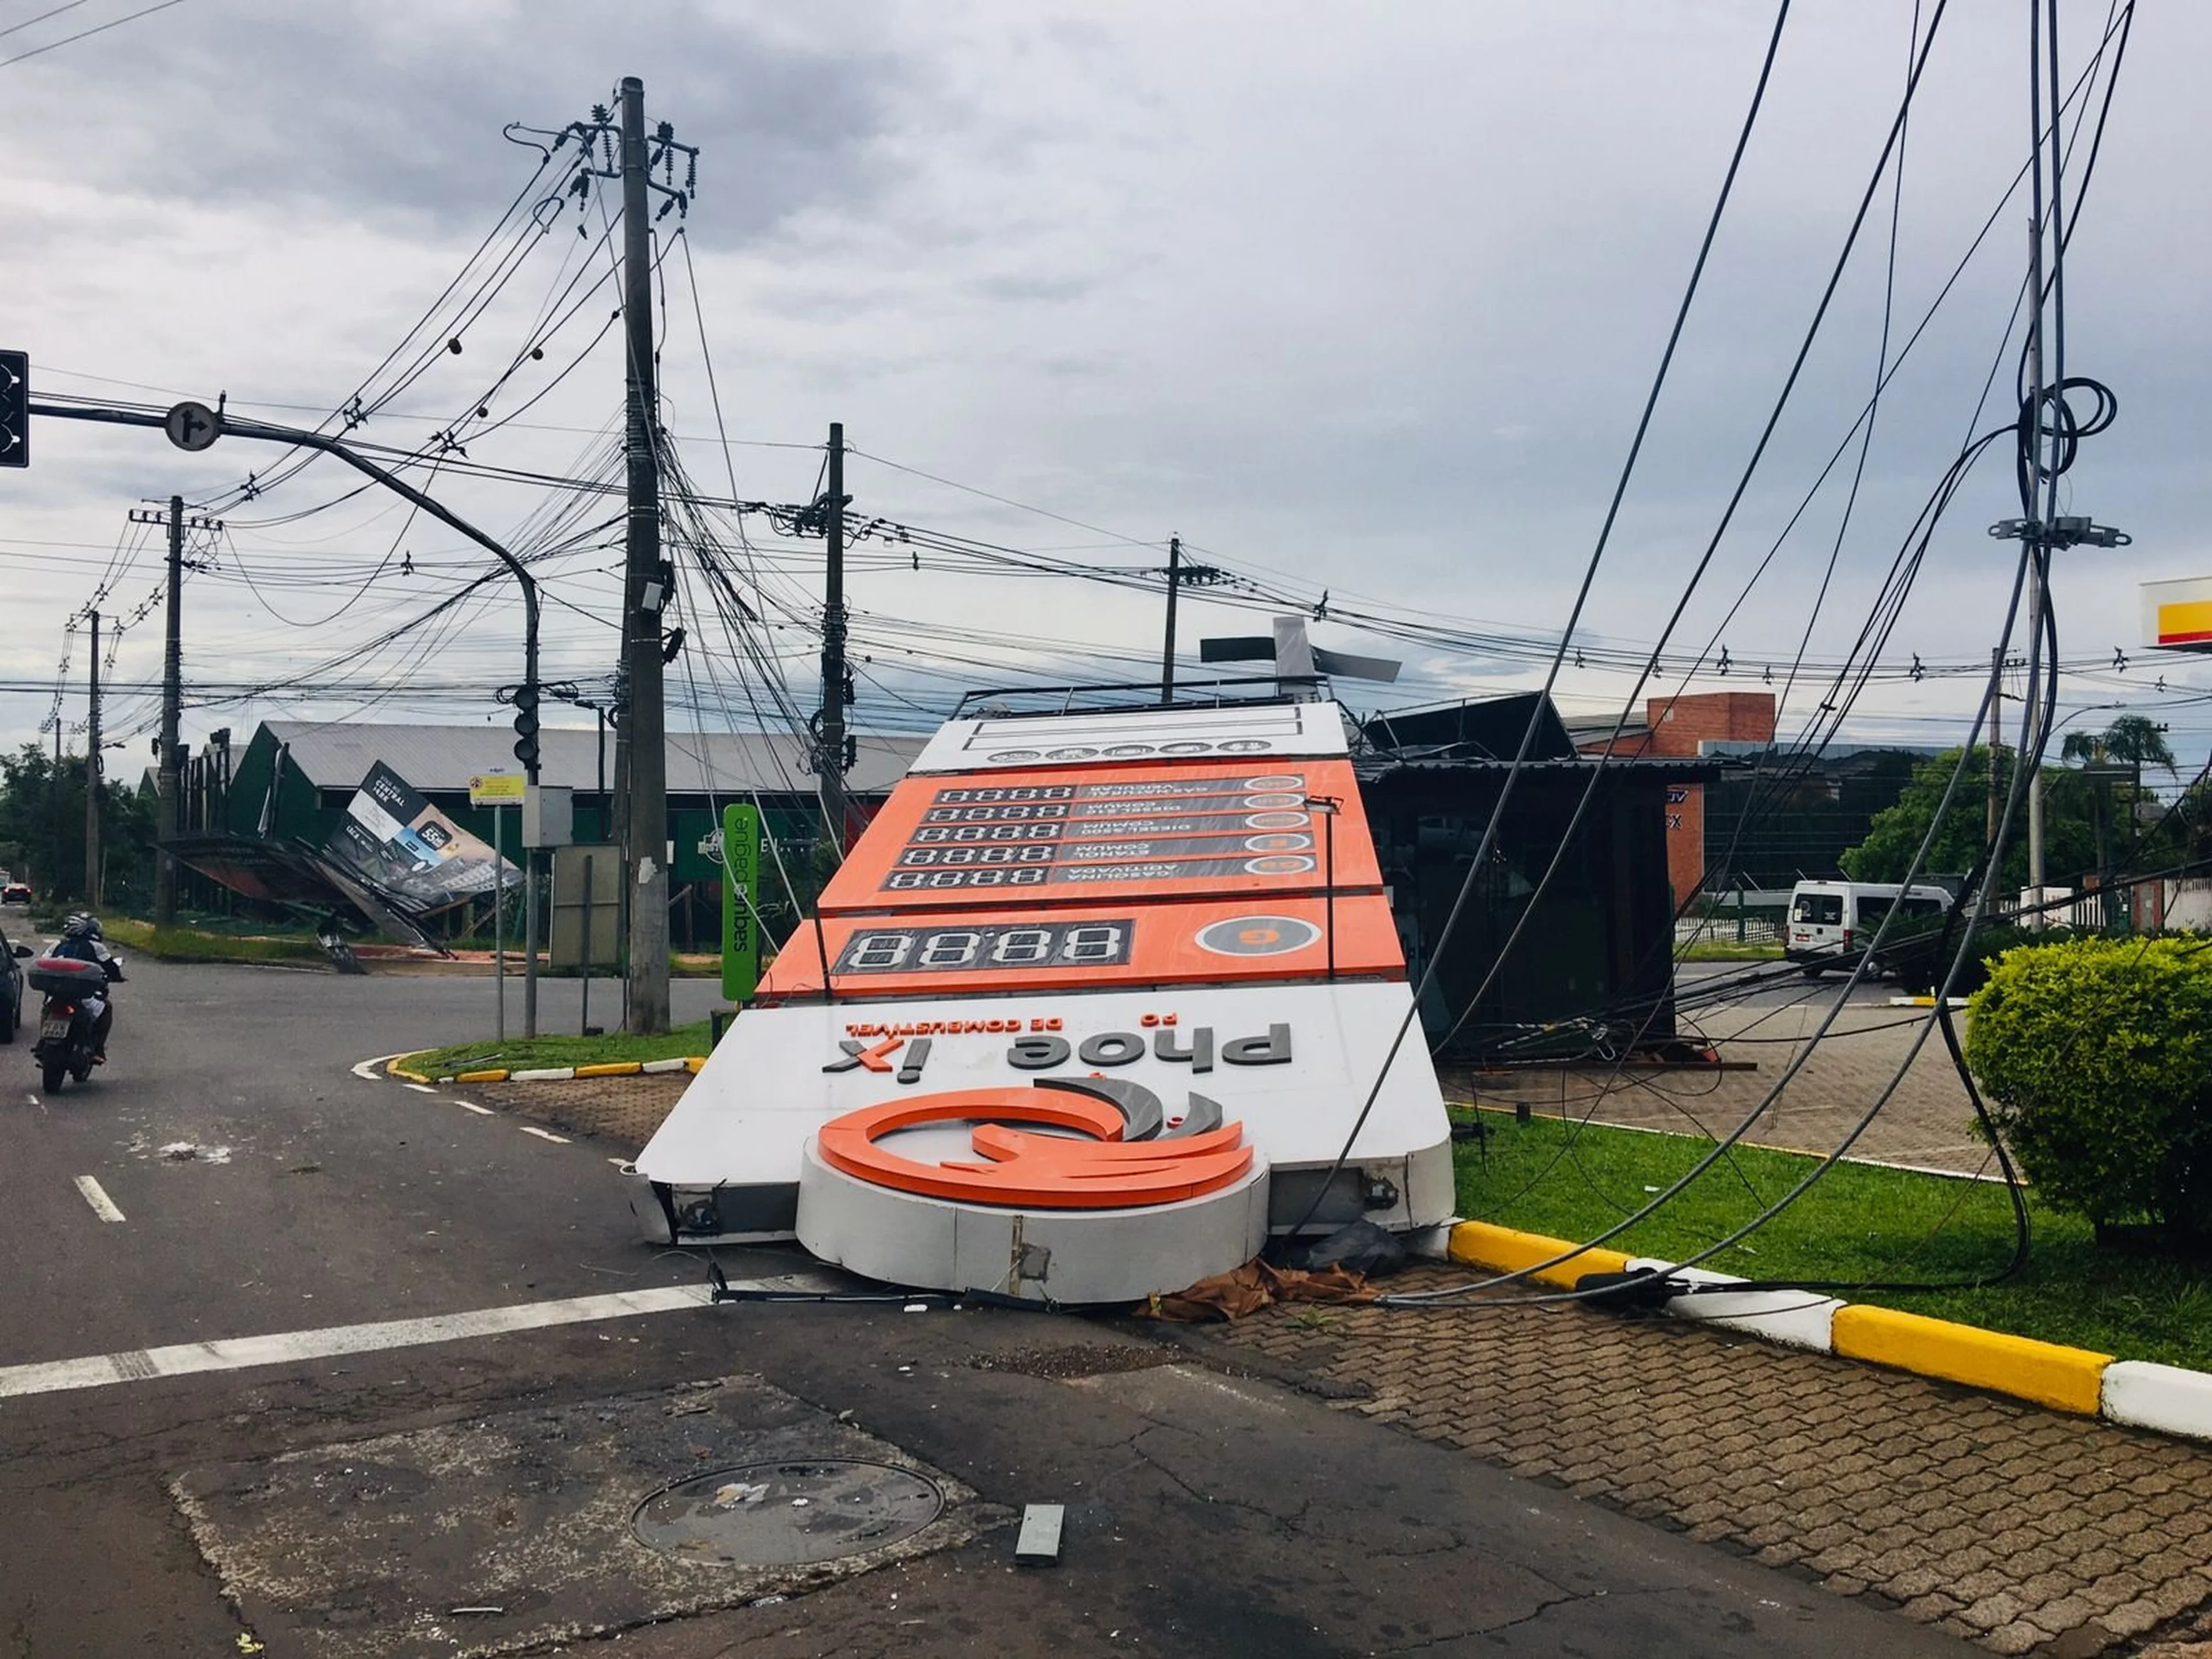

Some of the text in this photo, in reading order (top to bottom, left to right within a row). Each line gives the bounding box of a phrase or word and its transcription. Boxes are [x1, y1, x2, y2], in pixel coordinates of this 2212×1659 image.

[374, 779, 406, 807] CENTRAL
[1083, 820, 1154, 829] COMUM
[1127, 824, 1191, 833] DIESEL
[1075, 843, 1150, 853] COMUM
[1073, 849, 1150, 858] ETANOL
[1067, 870, 1169, 881] GASOLINA
[1239, 929, 1281, 945] G
[846, 1018, 1062, 1040] DE COMBUSTÍVEL
